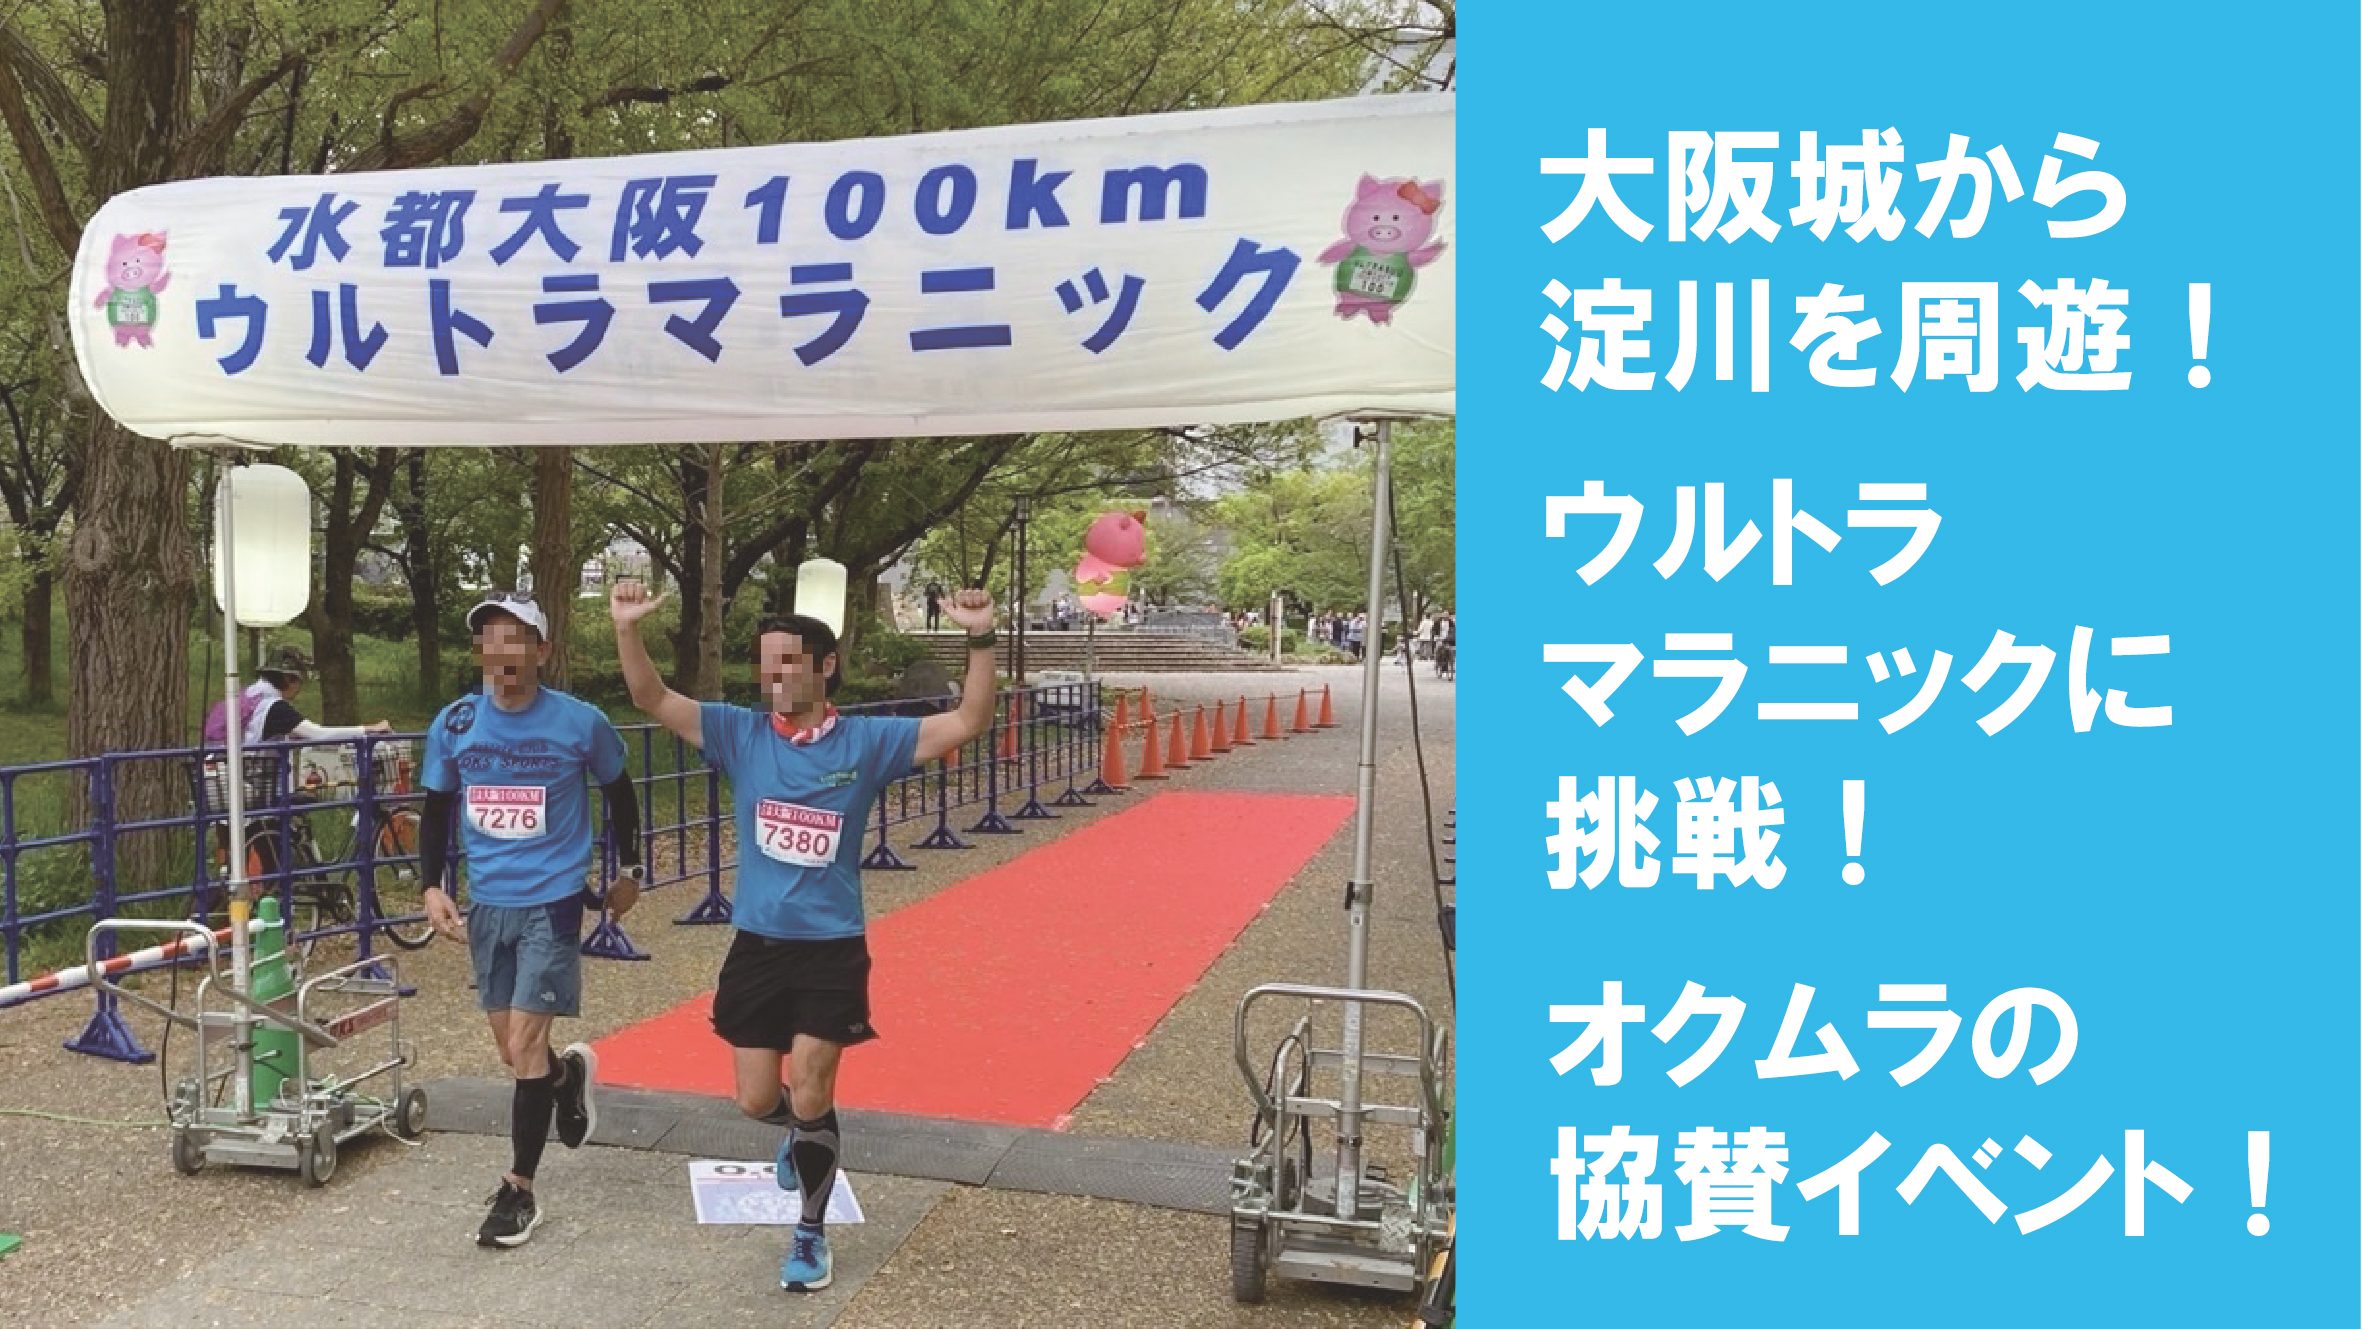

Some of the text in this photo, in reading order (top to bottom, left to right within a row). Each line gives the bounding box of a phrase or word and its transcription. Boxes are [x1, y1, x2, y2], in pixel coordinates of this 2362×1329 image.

[268, 157, 1207, 270] 水都大阪100km
[196, 237, 1299, 375] ウルトラマラニック
[474, 808, 538, 829] 7276
[764, 823, 830, 857] 7380
